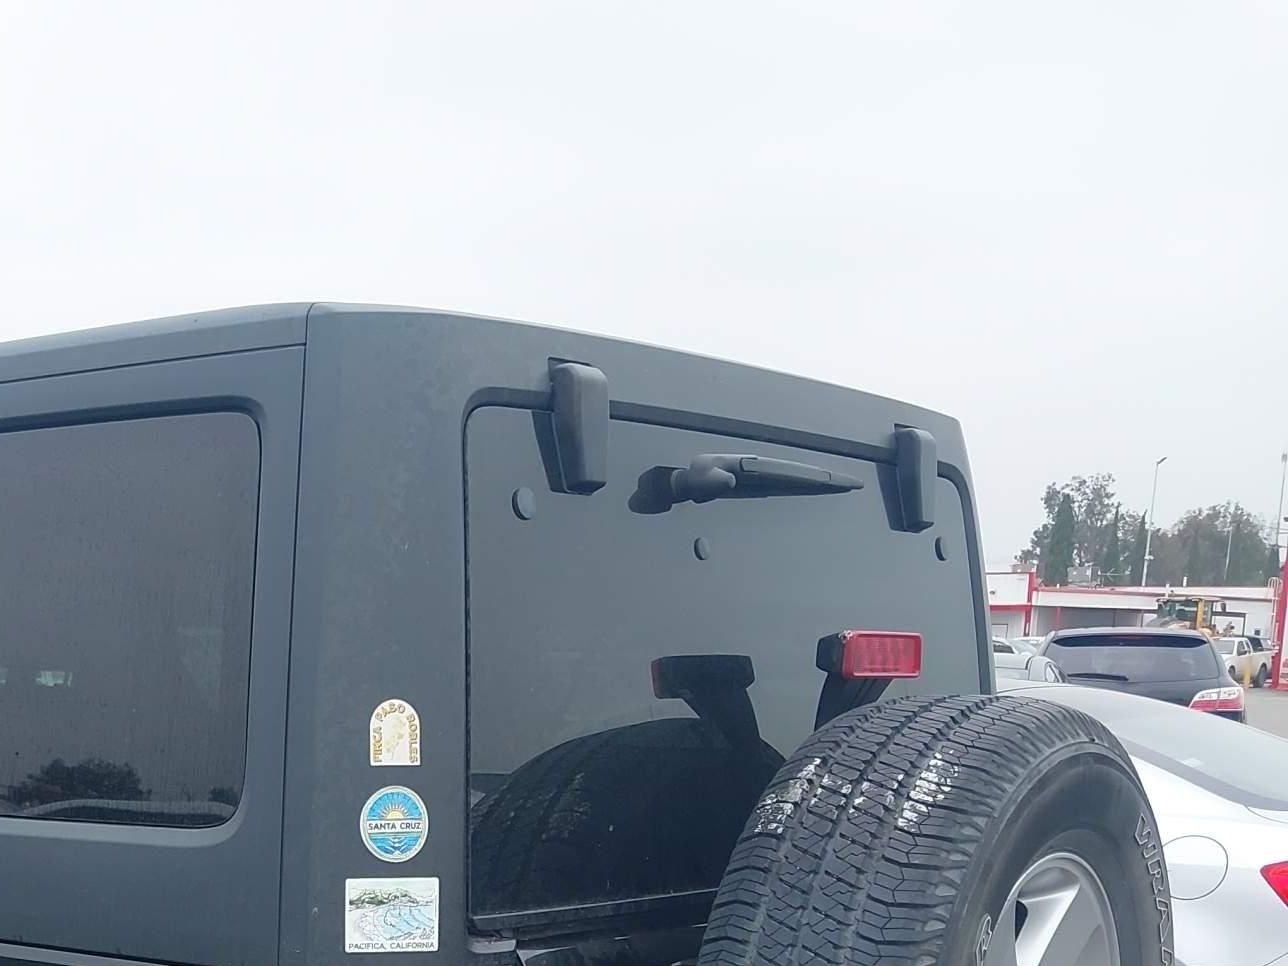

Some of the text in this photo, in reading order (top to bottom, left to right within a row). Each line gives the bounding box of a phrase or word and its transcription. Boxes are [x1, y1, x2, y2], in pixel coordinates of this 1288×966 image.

[368, 822, 422, 830] SANTA CRUZ
[348, 941, 435, 950] PACIFICA, CALIFORNIA
